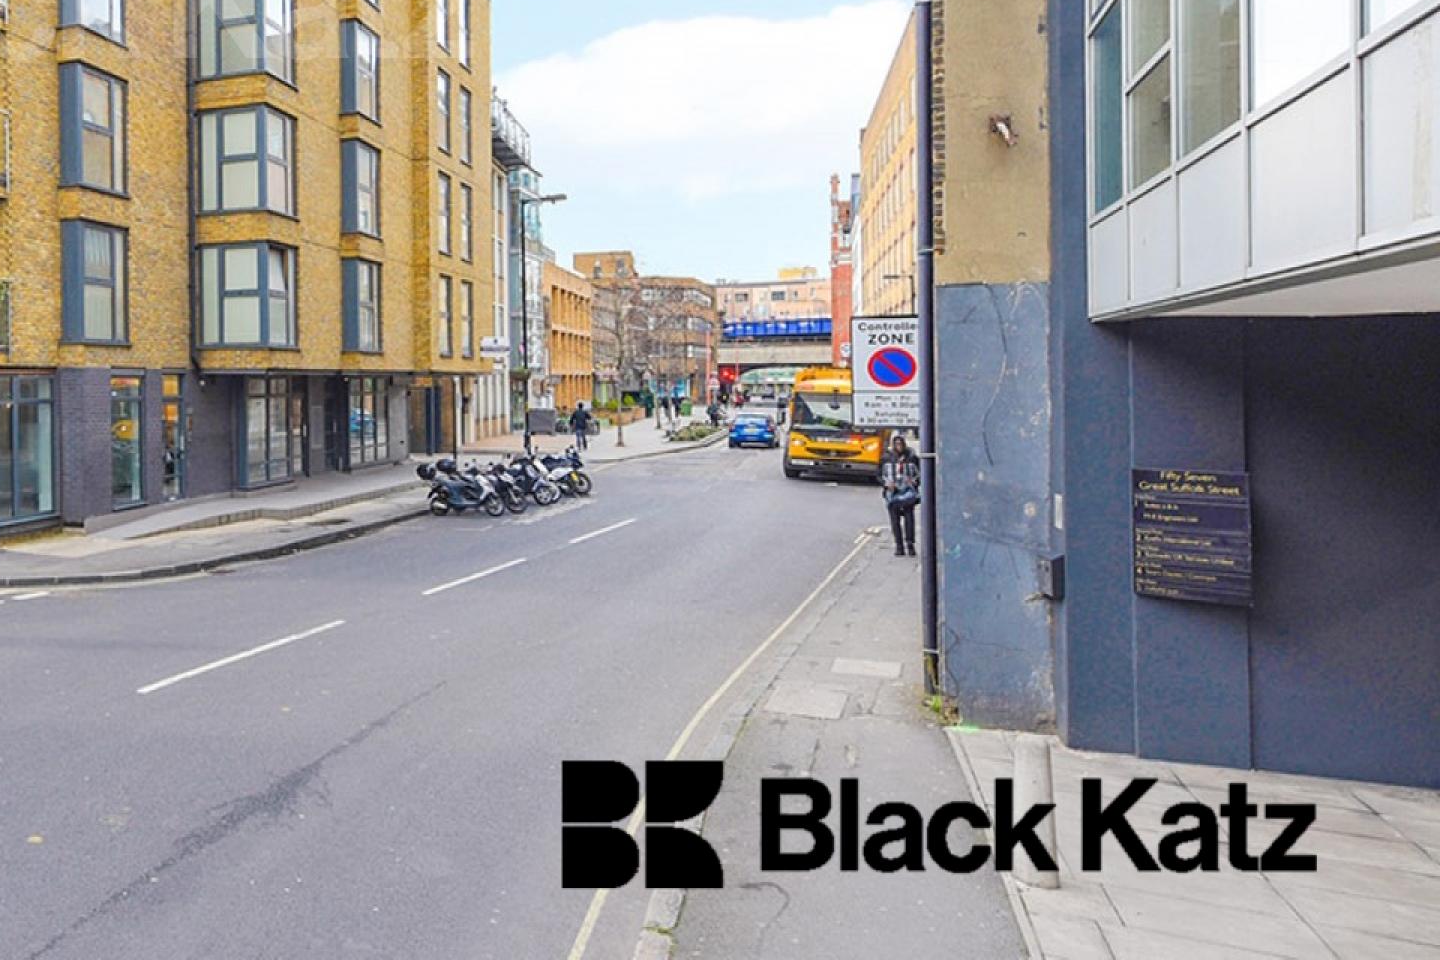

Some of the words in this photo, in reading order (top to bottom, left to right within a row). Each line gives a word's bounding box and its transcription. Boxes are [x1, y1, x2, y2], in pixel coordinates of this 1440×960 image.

[858, 322, 917, 331] Controlle
[868, 333, 915, 345] ZONE
[1207, 484, 1241, 496] Street
